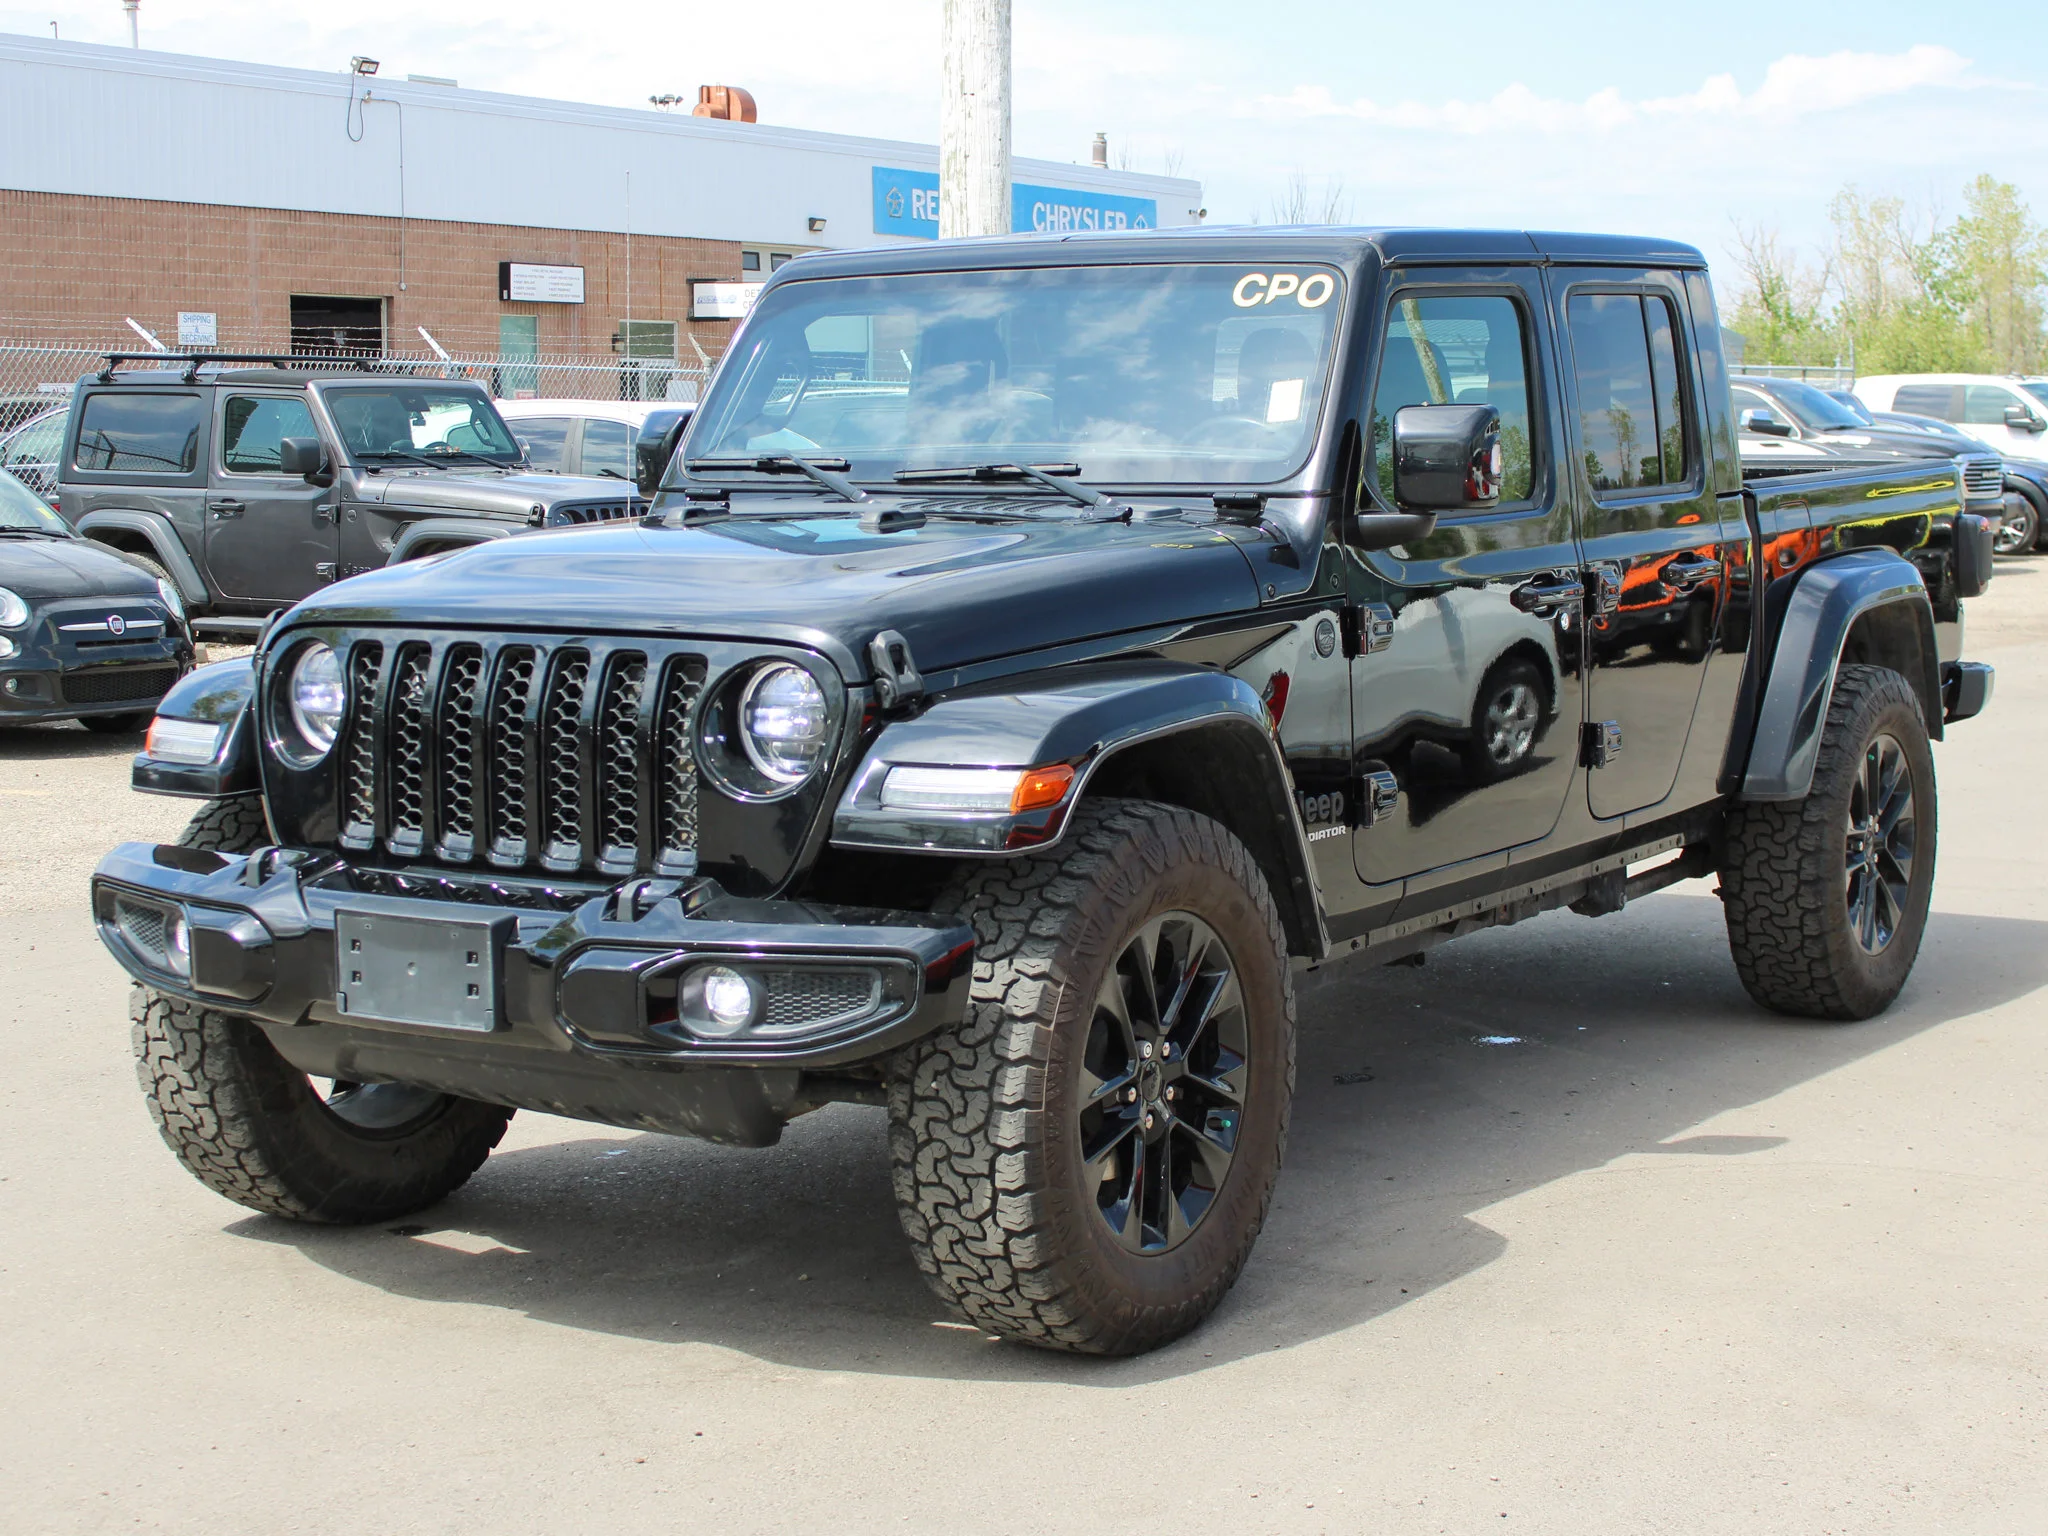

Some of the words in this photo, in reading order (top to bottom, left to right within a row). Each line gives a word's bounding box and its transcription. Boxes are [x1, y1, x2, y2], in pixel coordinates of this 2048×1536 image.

[911, 188, 940, 221] RE
[1032, 201, 1127, 233] CHRYSLER
[1233, 273, 1334, 308] CPO
[183, 314, 212, 324] SHIPPING
[181, 333, 215, 344] RECEIVING
[1308, 825, 1346, 842] DIATOR
